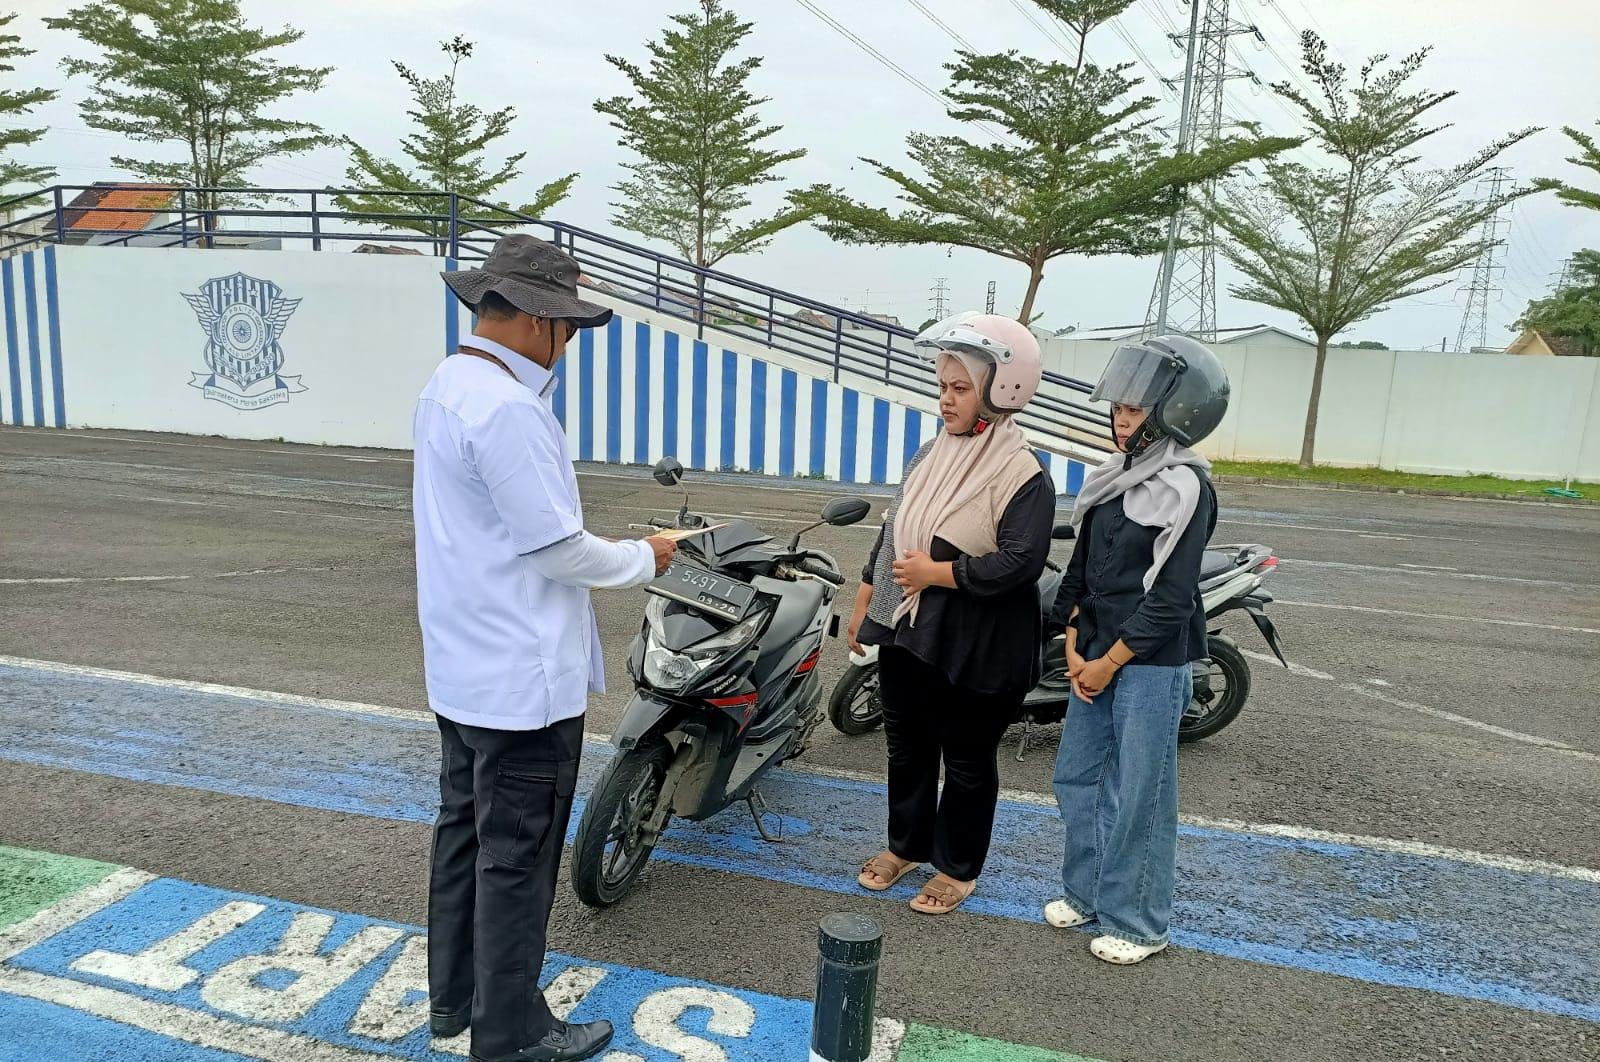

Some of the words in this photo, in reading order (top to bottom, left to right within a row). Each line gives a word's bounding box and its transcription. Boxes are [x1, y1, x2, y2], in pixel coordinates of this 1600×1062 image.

[229, 306, 255, 316] POLISI
[682, 570, 718, 591] 5497
[712, 674, 738, 695] HONDA
